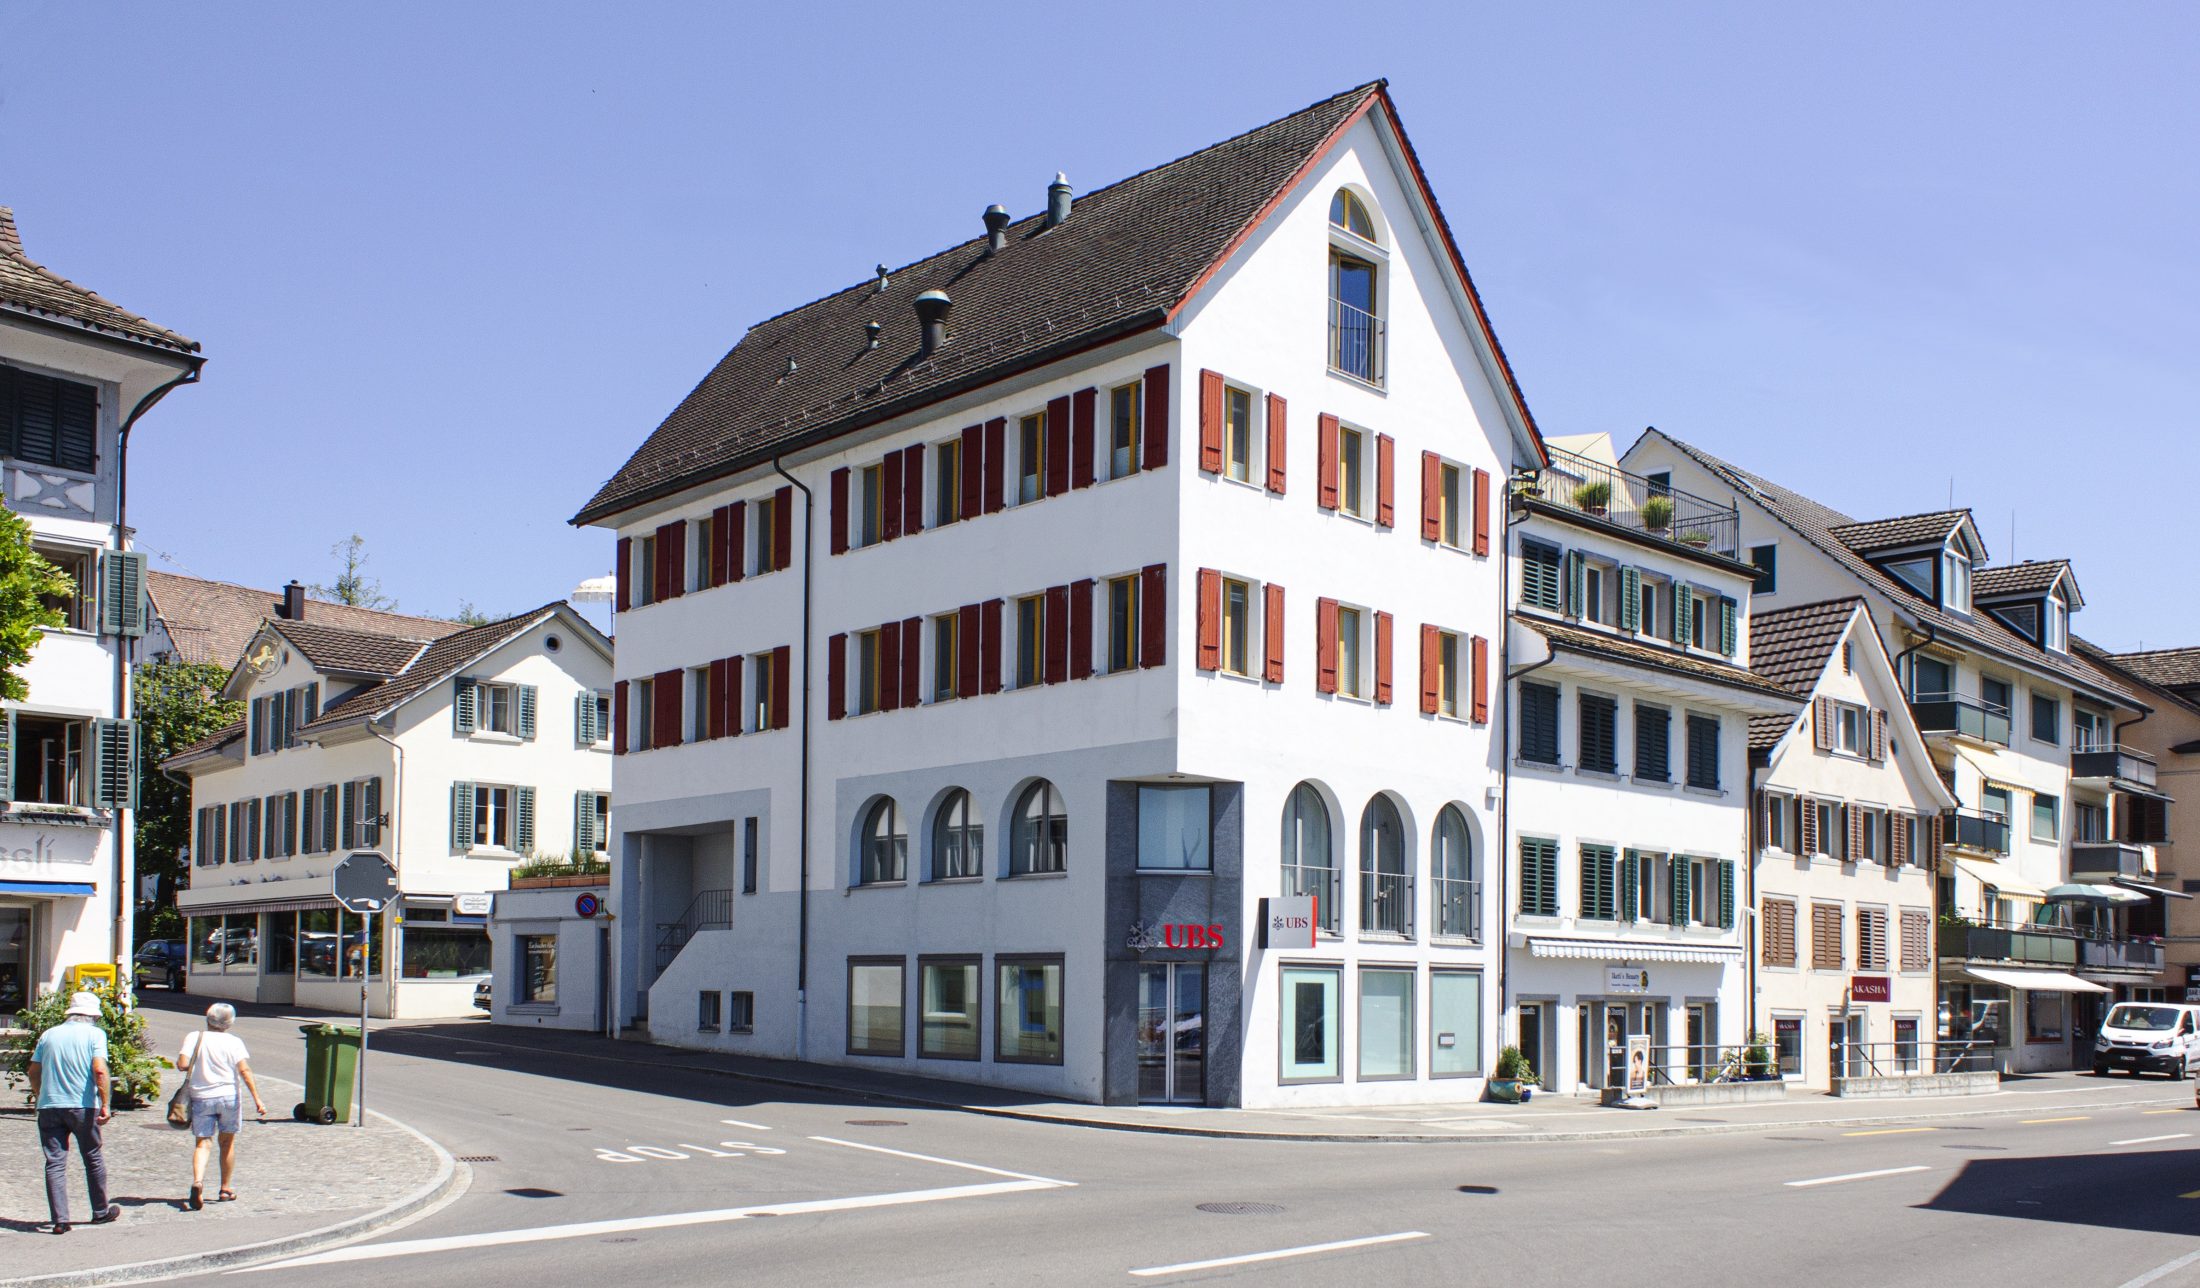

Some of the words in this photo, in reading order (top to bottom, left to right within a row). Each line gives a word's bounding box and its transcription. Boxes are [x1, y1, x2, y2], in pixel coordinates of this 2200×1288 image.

[1286, 917, 1308, 928] UBS
[1163, 923, 1225, 949] UBS
[1853, 984, 1887, 994] AKASHA
[594, 1141, 787, 1162] STOP
